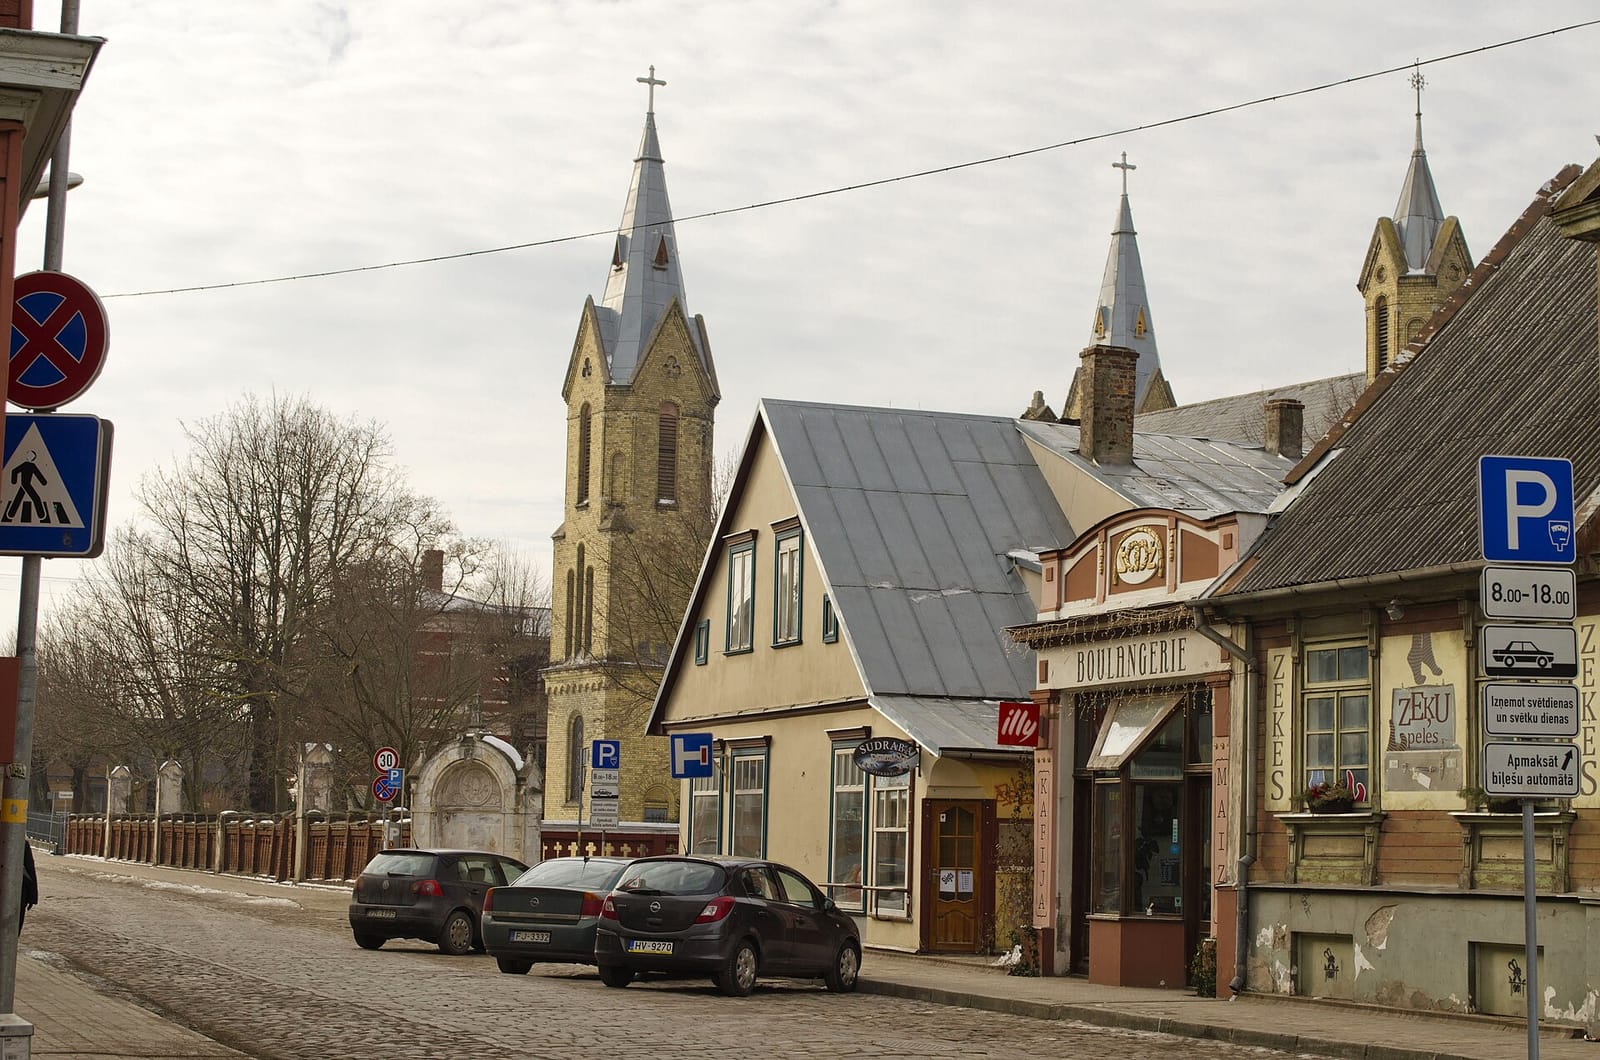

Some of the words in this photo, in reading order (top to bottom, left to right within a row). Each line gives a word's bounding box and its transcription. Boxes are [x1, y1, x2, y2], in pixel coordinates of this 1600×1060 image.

[1505, 469, 1557, 549] P
[1491, 582, 1570, 605] 8.00-18.00
[1077, 637, 1188, 683] BOULANGERIE
[1491, 695, 1525, 709] Izņemot
[1527, 696, 1574, 709] svētdienas
[1001, 708, 1038, 743] illy
[1496, 713, 1507, 723] un
[1509, 712, 1538, 724] svētku
[1541, 712, 1569, 724] dienas
[380, 753, 393, 767] 30
[598, 743, 616, 767] P
[1507, 753, 1558, 770] Apmaksāt
[390, 770, 399, 780] P
[1492, 771, 1523, 787] biļešu
[1526, 773, 1574, 786] automātā
[1038, 778, 1048, 910] KAFIJA
[635, 942, 672, 952] HV-9270
